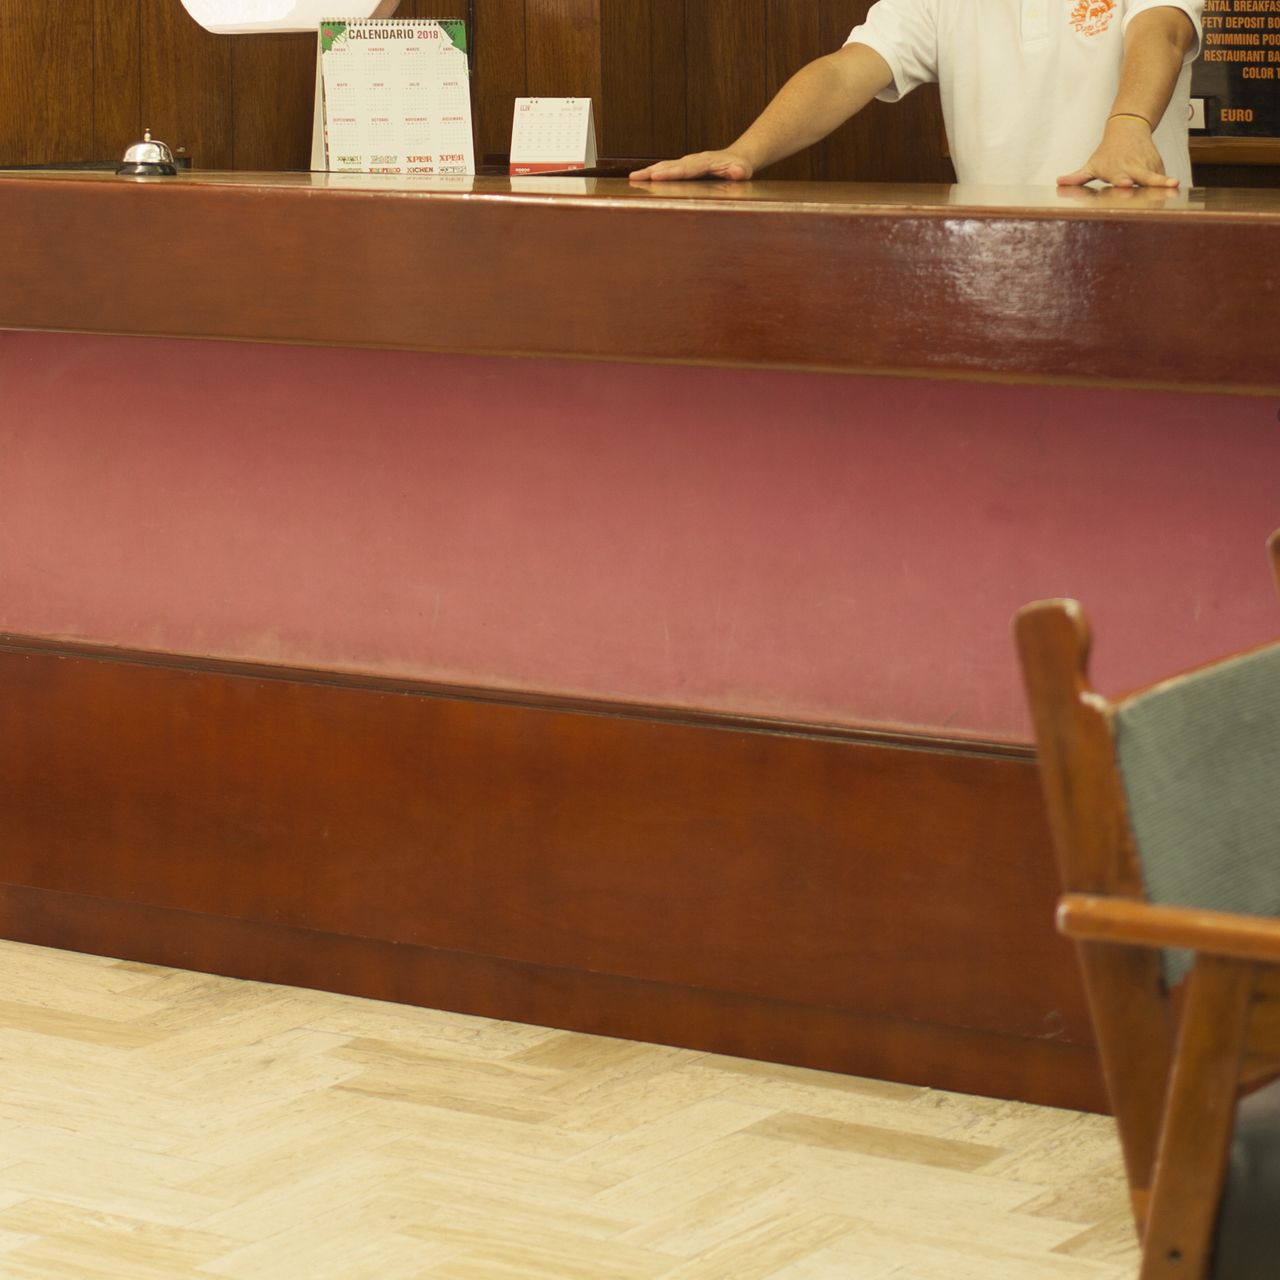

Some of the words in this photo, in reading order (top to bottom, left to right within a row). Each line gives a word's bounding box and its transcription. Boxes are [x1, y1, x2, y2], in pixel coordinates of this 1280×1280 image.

[1226, 17, 1264, 29] DEPOSIT
[348, 29, 414, 39] CALENDARIO
[417, 30, 439, 39] 2018
[1206, 33, 1260, 45] SWIMMING
[1204, 50, 1265, 62] RESTAURANT
[1242, 67, 1273, 79] COLOR
[1221, 109, 1253, 122] EURO
